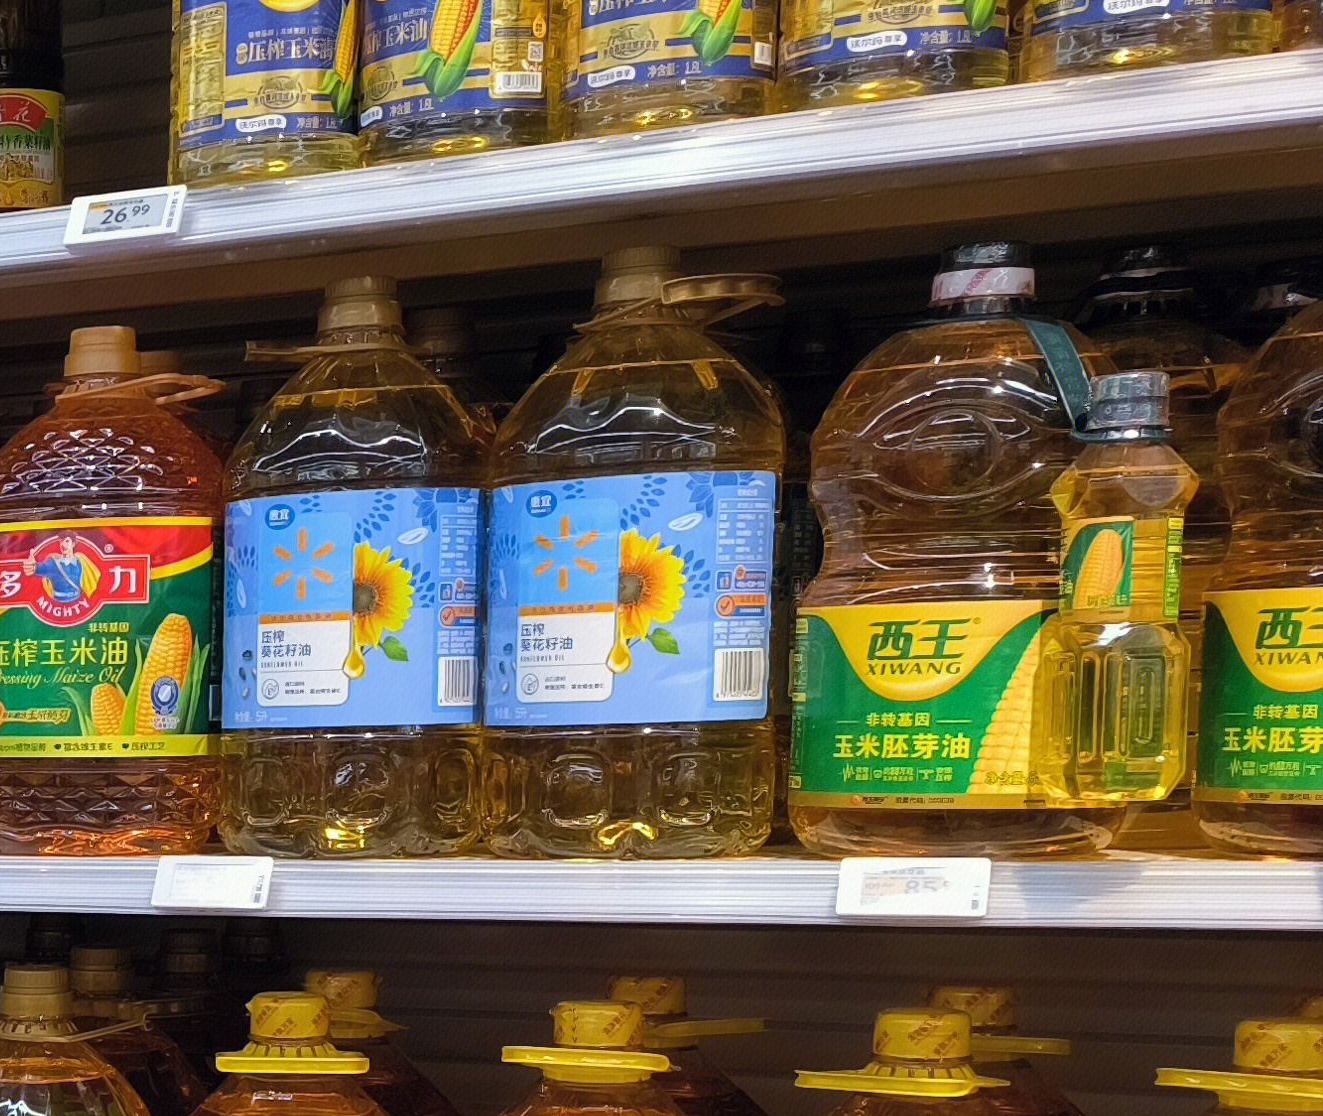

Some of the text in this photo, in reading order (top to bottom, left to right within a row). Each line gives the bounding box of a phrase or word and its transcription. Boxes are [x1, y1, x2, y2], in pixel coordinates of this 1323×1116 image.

[37, 596, 91, 618] MIGHTY
[261, 630, 284, 643] 压榨
[521, 623, 544, 636] 压榨
[521, 637, 572, 652] 葵花籽油
[867, 619, 971, 660] 西王
[260, 644, 312, 658] 葵花籽油
[866, 661, 961, 675] XIWANG
[1253, 704, 1318, 719] 非转基因
[866, 712, 930, 727] 非转基因
[833, 733, 970, 759] 玉米胚芽油
